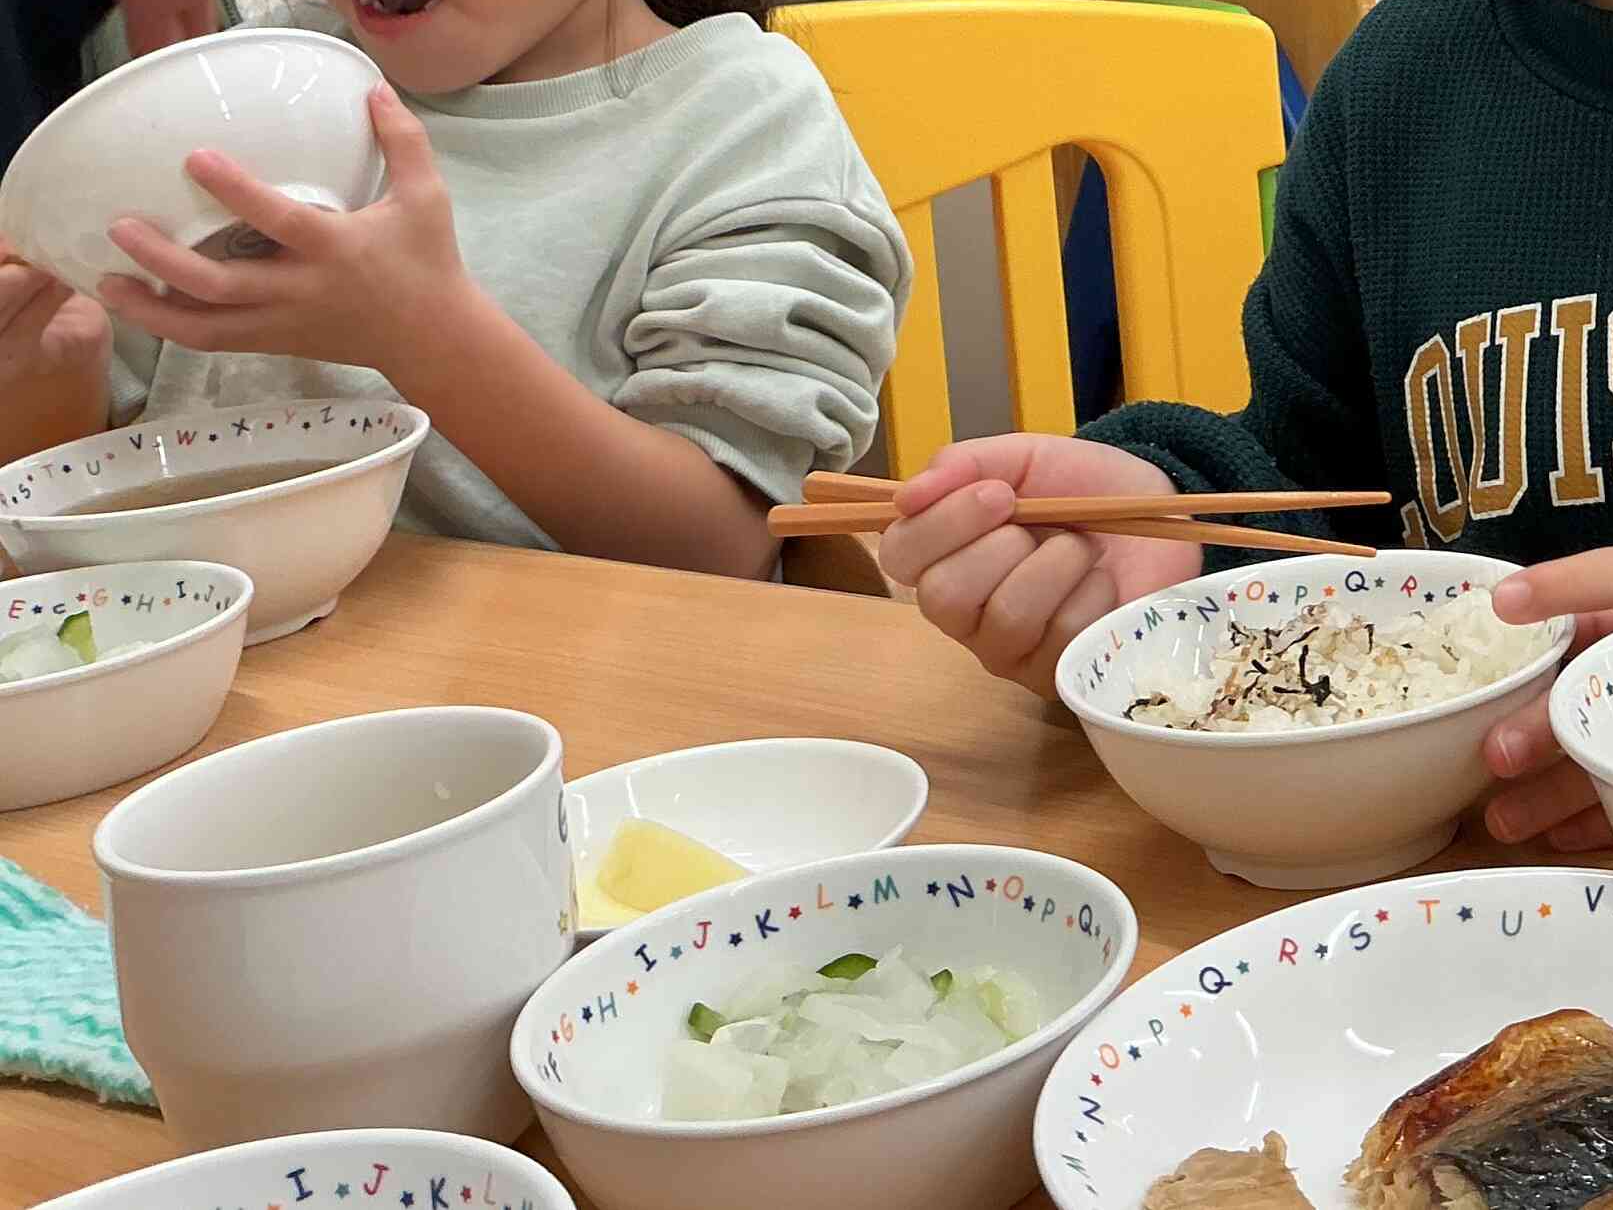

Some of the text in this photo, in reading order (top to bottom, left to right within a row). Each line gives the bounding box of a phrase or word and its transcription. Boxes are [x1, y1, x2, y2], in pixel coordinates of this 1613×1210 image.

[86, 459, 100, 476] U
[129, 433, 142, 450] V
[176, 429, 198, 446] W
[231, 417, 249, 437] X
[320, 406, 334, 424] Z
[7, 598, 26, 620] E
[92, 588, 108, 606] G
[136, 593, 154, 613] H
[176, 581, 186, 598] I
[1144, 606, 1164, 631] M
[1196, 596, 1221, 622] N
[1246, 581, 1265, 601] O
[1295, 585, 1308, 605] P
[1345, 571, 1369, 592] Q
[1400, 575, 1418, 598] R
[1589, 674, 1601, 699] O
[560, 1013, 575, 1043] G
[597, 992, 618, 1022] H
[635, 944, 657, 972] I
[692, 921, 712, 950] J
[755, 909, 779, 939] K
[817, 883, 834, 909] L
[874, 874, 900, 904] M
[947, 874, 975, 907] N
[1003, 875, 1025, 901] O
[1041, 897, 1055, 922] P
[1079, 904, 1094, 936] Q
[1079, 1095, 1104, 1125] N
[1099, 1043, 1120, 1069] O
[1148, 1018, 1164, 1046] P
[1200, 966, 1233, 994] Q
[1279, 938, 1298, 966] R
[1349, 922, 1371, 951] S
[1417, 900, 1440, 924] T
[1502, 910, 1523, 937] U
[1585, 884, 1604, 912] V
[286, 1163, 497, 1210] I J K L
